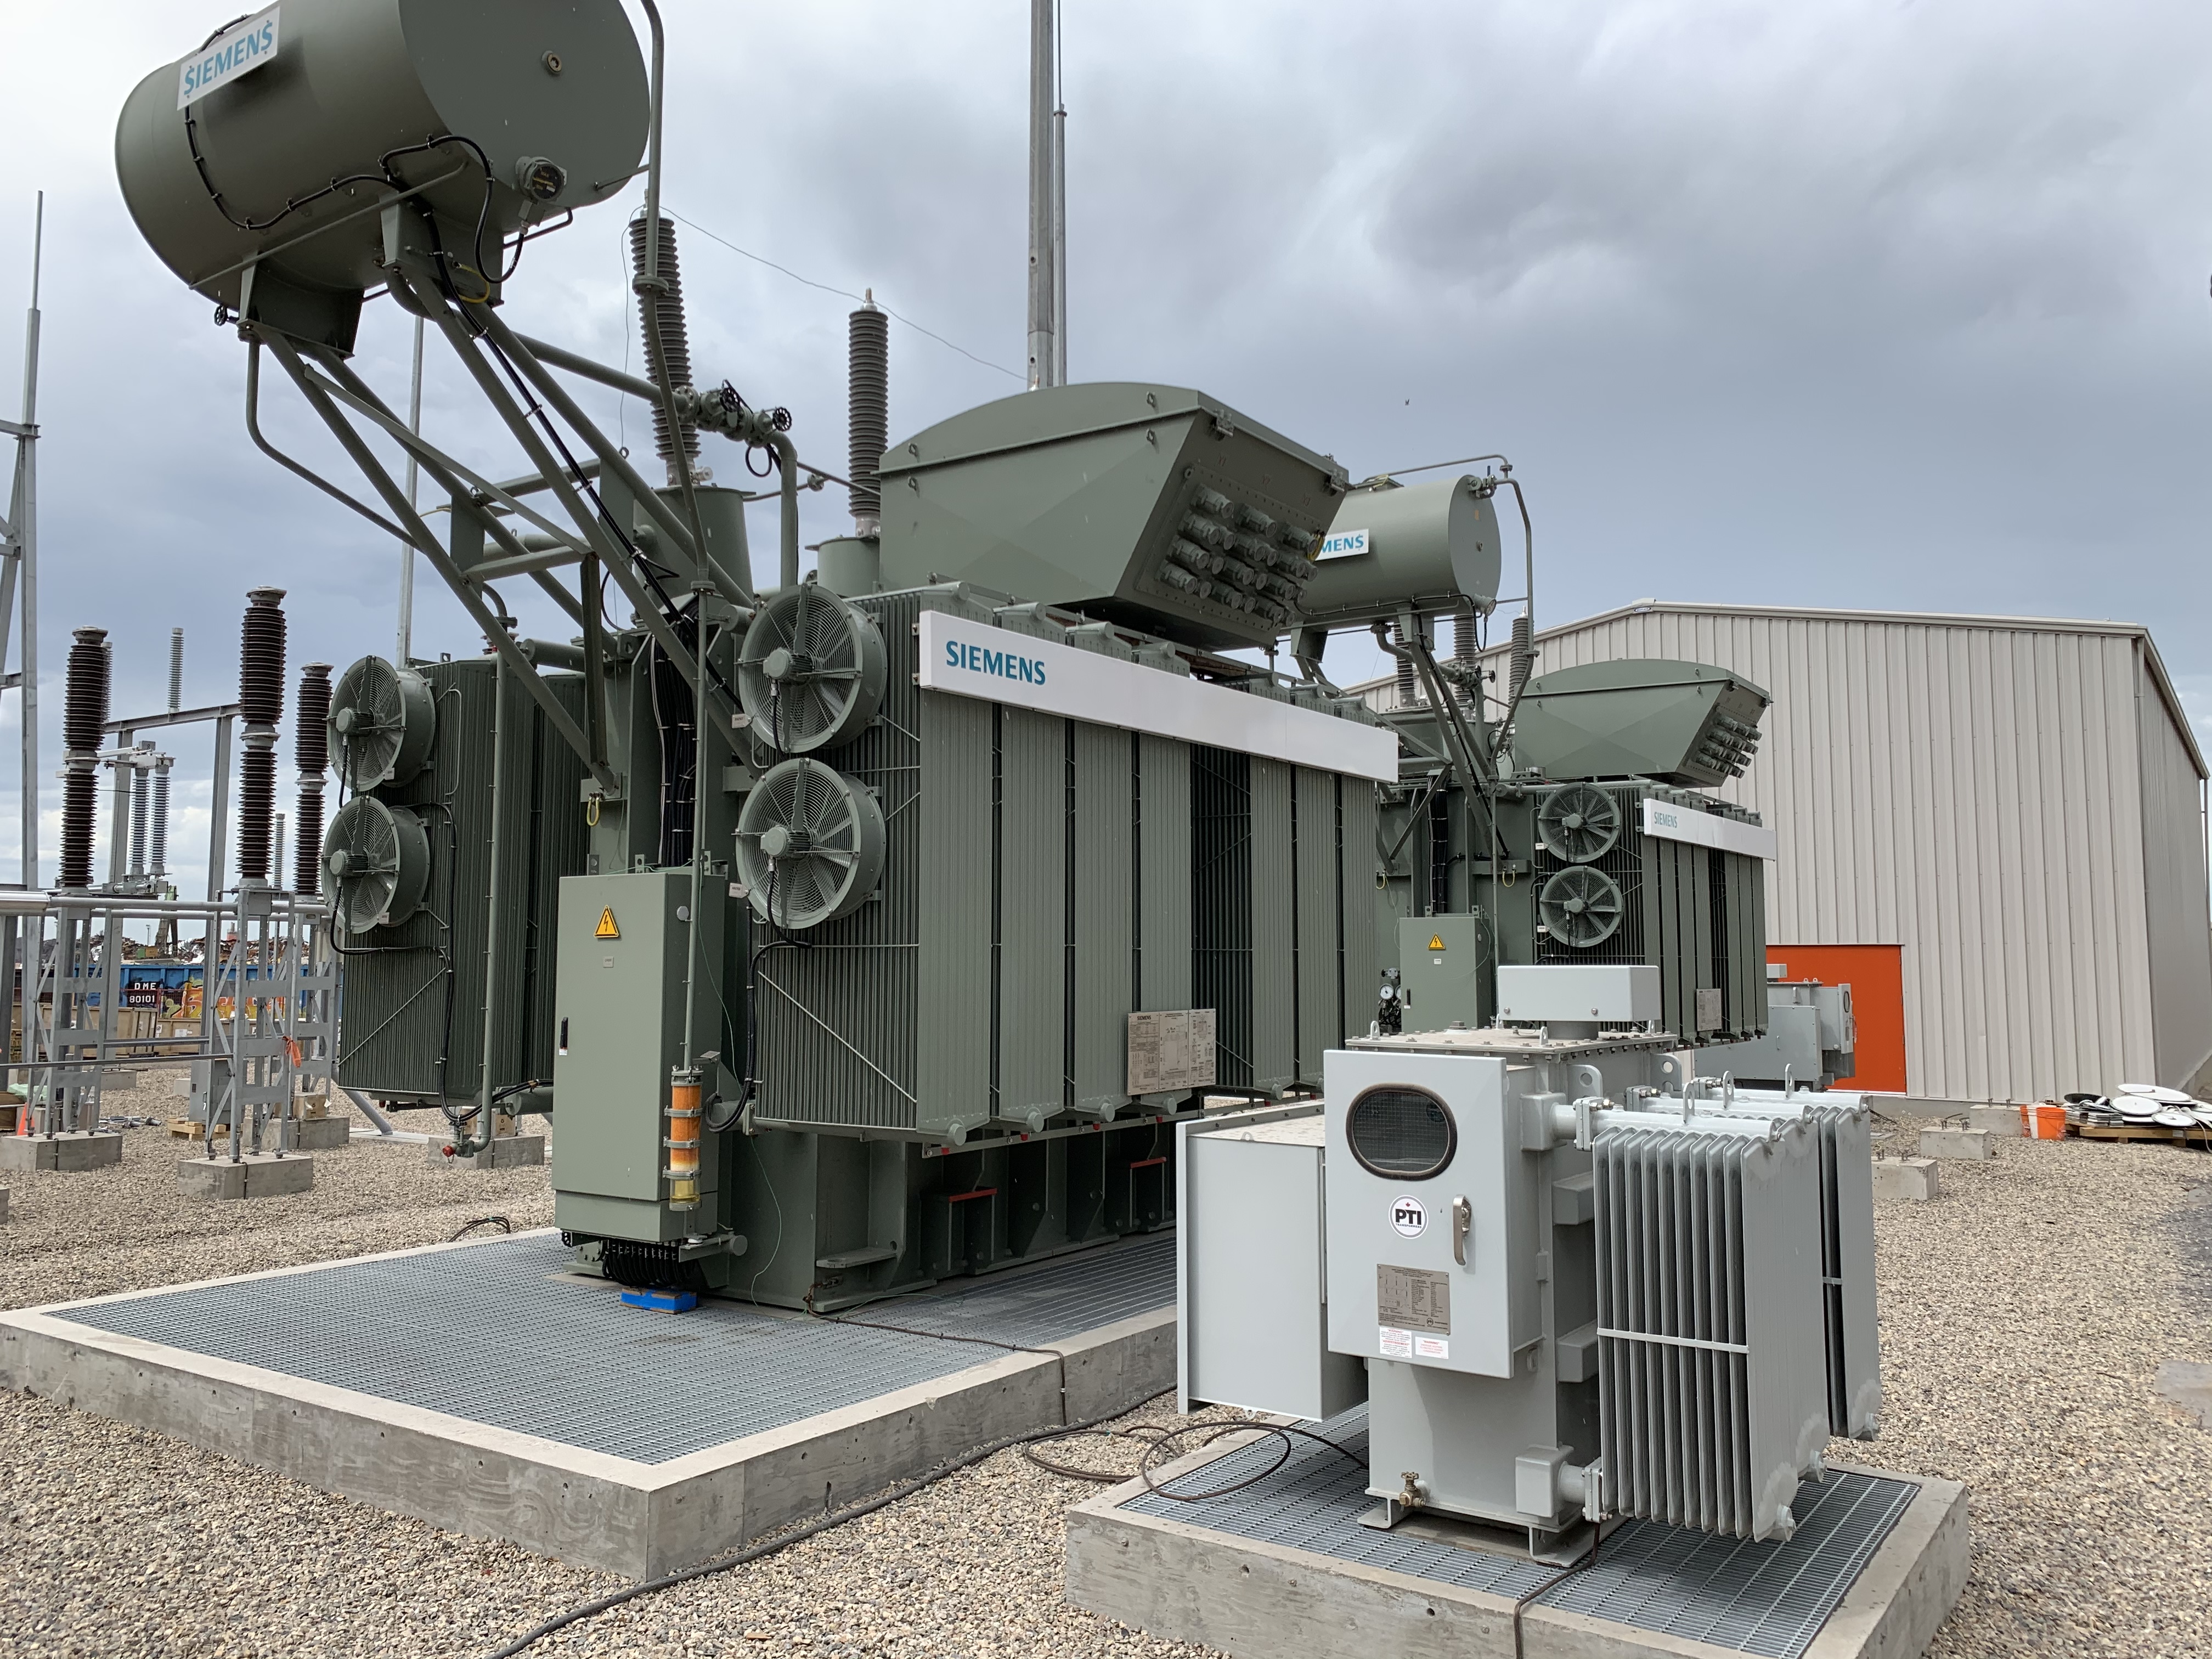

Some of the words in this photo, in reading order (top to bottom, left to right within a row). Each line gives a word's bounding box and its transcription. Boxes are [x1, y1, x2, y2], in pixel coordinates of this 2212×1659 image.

[184, 22, 273, 95] SIEMENS
[1322, 535, 1364, 553] MENS
[946, 641, 1046, 686] SIEMENS
[1654, 811, 1677, 828] SIEMENS
[1395, 1209, 1421, 1225] PTI
